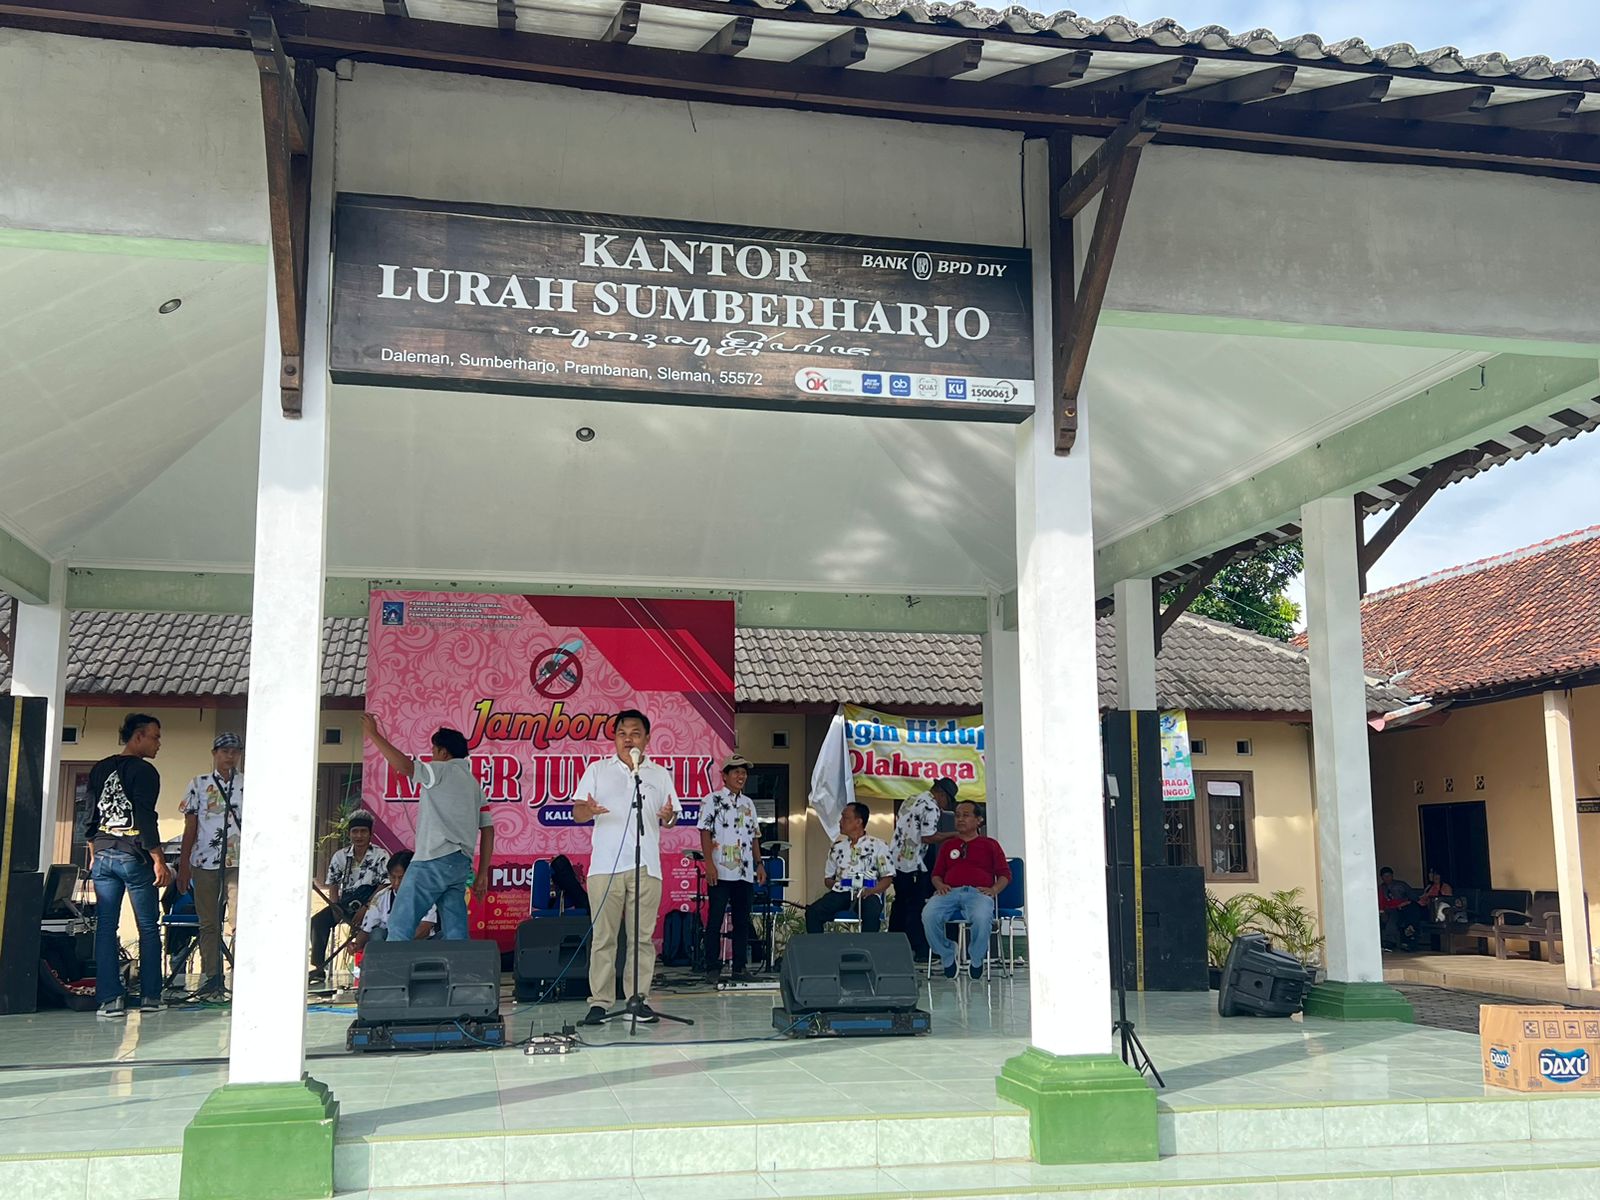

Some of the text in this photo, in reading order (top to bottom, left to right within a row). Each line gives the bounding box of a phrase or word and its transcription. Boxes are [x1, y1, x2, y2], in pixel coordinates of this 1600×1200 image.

[579, 232, 812, 284] KANTOR
[861, 254, 909, 270] BANK
[937, 260, 1007, 277] BPD DIY
[377, 264, 991, 349] LURAH SUMBERHARJO
[381, 348, 763, 386] Daleman, Sumberharjo, Prambanan, Sleman, 55572
[948, 383, 964, 394] KU
[971, 388, 1010, 399] 1500061
[383, 753, 521, 802] KER
